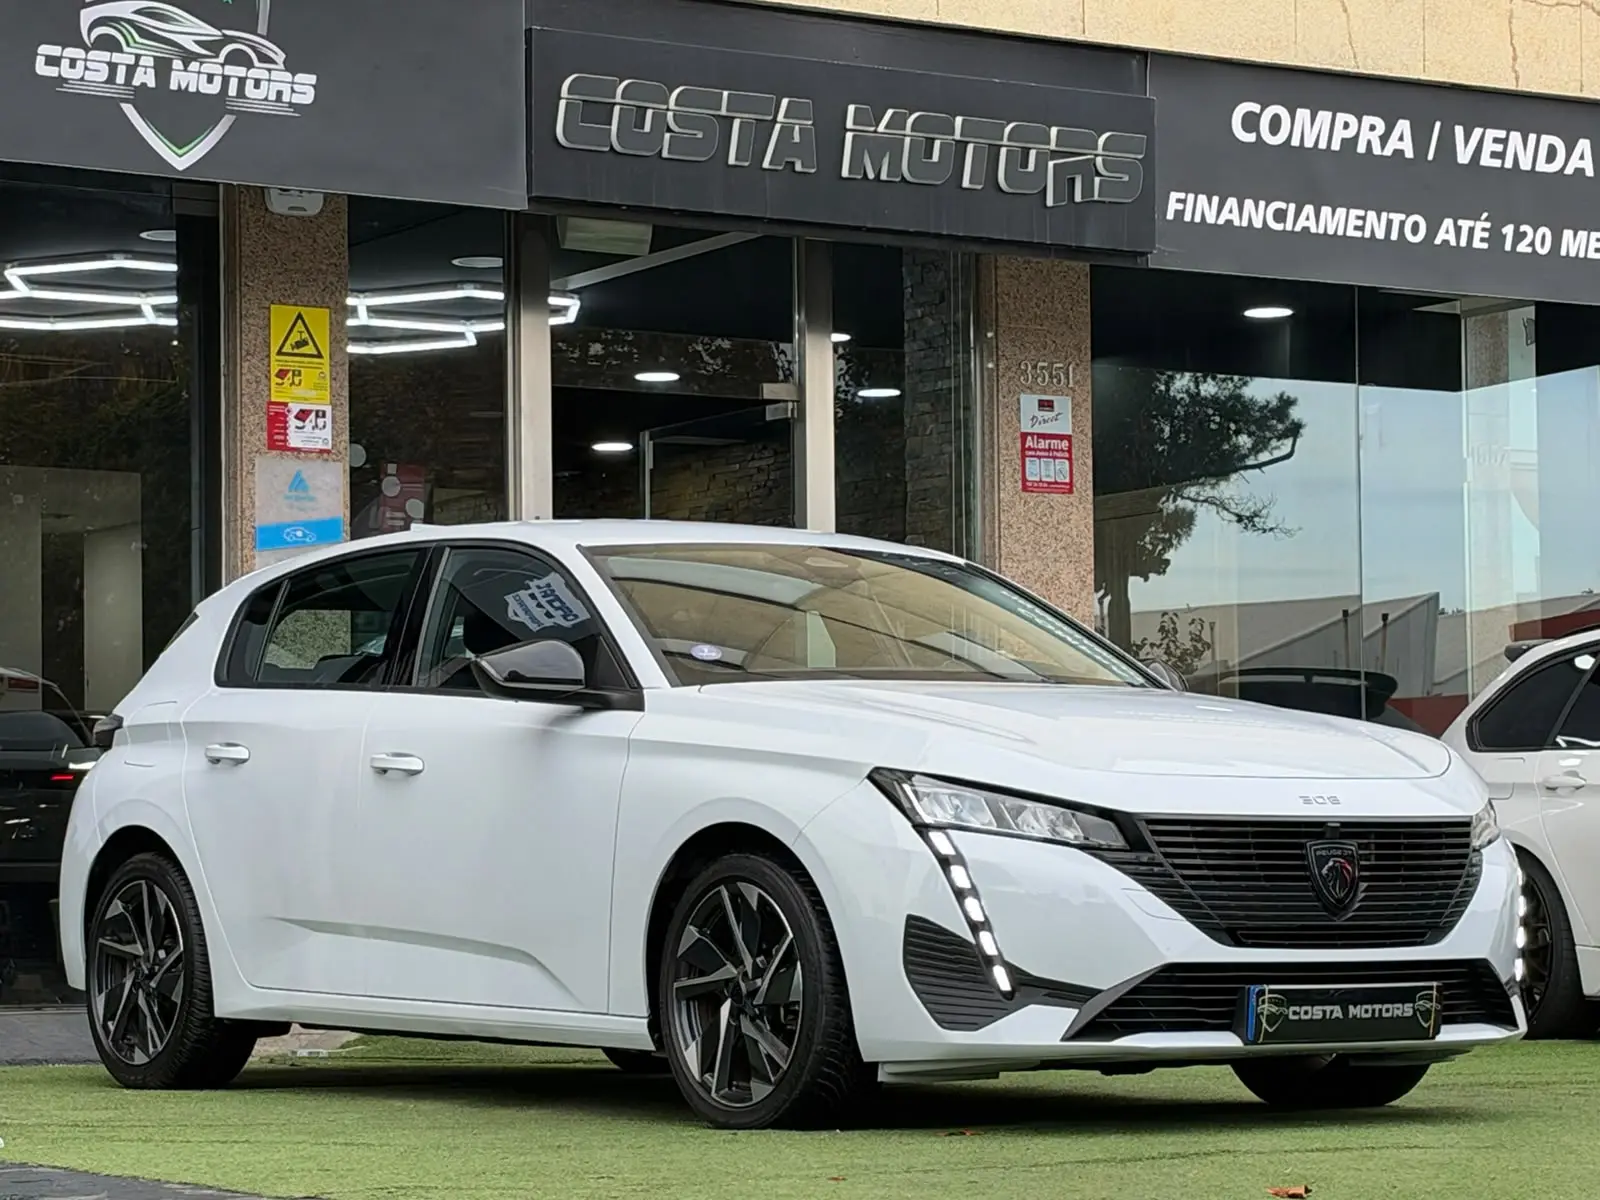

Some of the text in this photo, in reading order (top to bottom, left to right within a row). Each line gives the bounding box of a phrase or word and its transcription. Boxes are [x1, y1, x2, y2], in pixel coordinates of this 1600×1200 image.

[35, 44, 317, 105] COSTA MOTORS
[556, 72, 1148, 207] COSTA MOTORS
[1231, 101, 1595, 178] COMPRA / VENDA
[1166, 191, 1427, 243] FINANCIAMENTO
[1434, 212, 1492, 250] ATÉ
[1500, 223, 1552, 256] 120
[1020, 360, 1075, 388] 3551
[1030, 412, 1063, 428] Direct
[1025, 435, 1069, 451] Alarme
[1288, 1002, 1413, 1020] COSTA MOTORS
